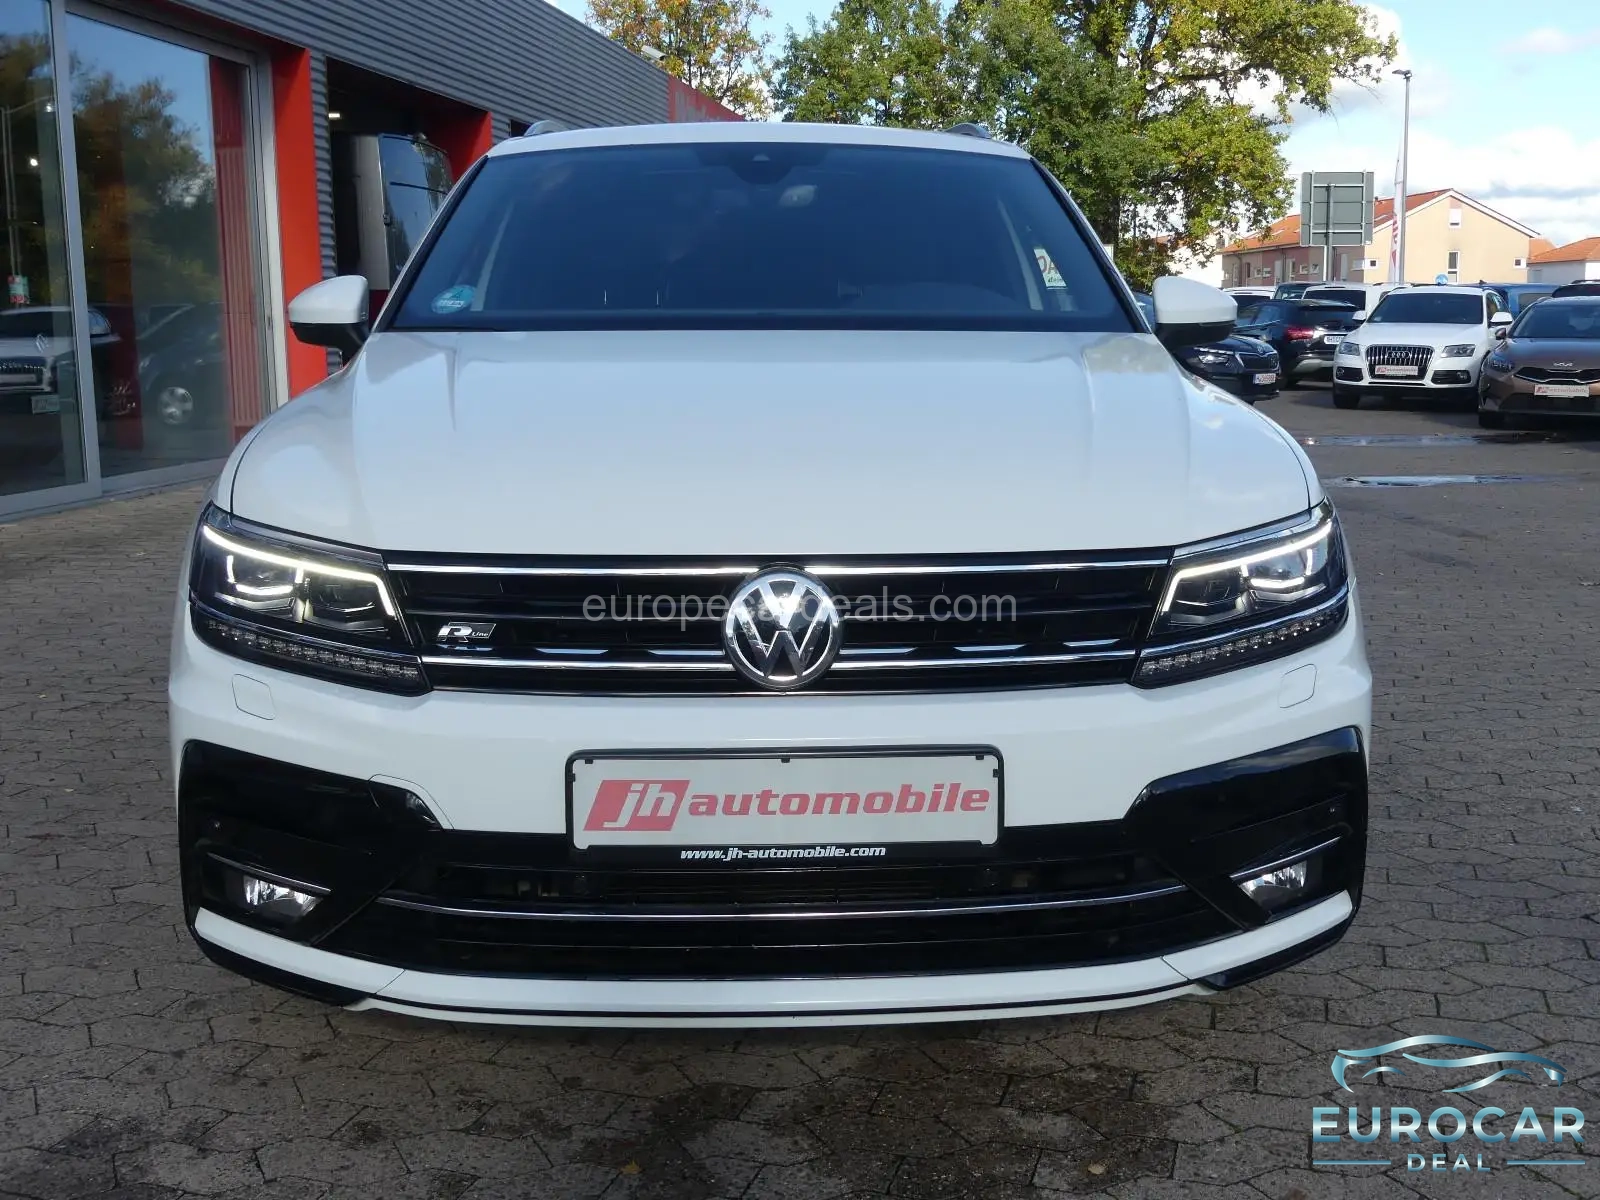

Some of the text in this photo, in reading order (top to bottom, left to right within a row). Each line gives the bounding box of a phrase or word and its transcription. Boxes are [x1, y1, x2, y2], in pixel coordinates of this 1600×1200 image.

[731, 577, 834, 680] VW
[603, 783, 990, 827] jh automobile
[680, 845, 886, 861] www.jh-automobile.com
